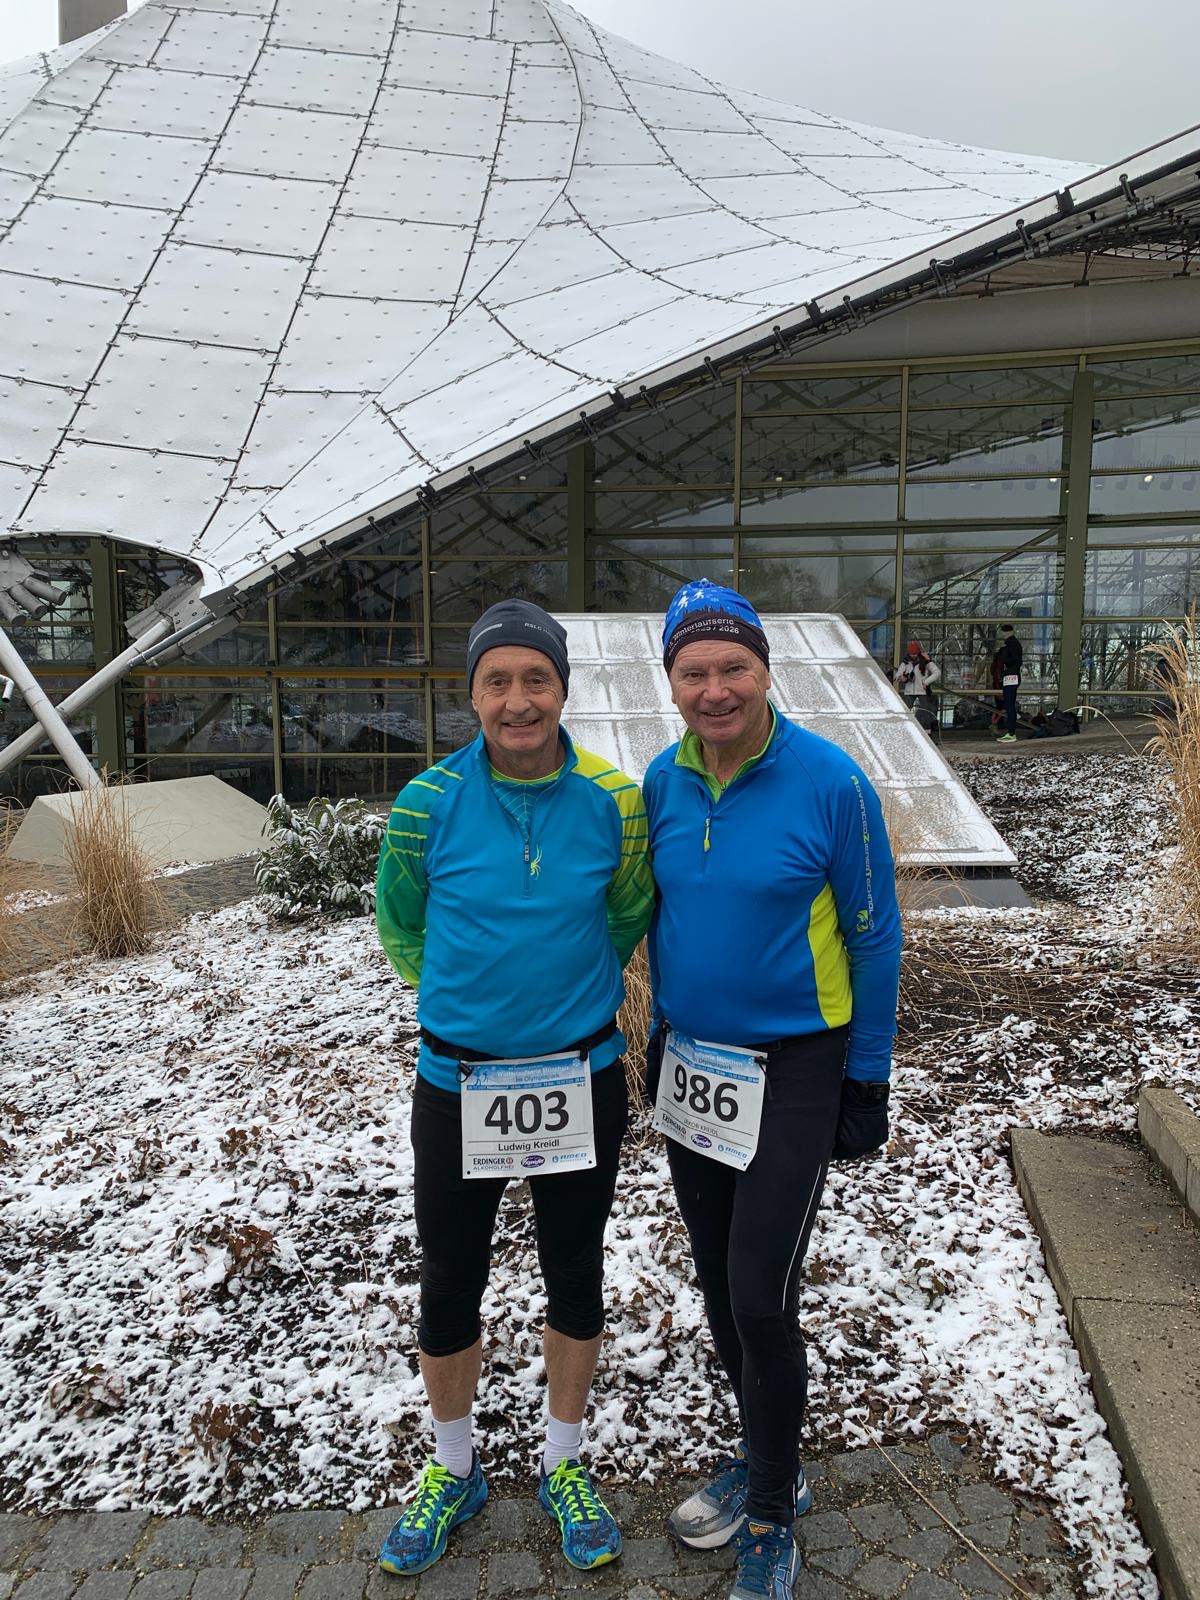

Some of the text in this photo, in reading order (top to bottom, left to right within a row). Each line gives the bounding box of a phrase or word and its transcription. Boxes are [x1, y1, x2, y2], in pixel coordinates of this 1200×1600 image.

[719, 626, 740, 634] 2026
[673, 1064, 739, 1122] 986
[485, 1090, 569, 1135] 403
[498, 1139, 560, 1152] Ludwig Kreidl
[473, 1157, 506, 1166] ERDINGER
